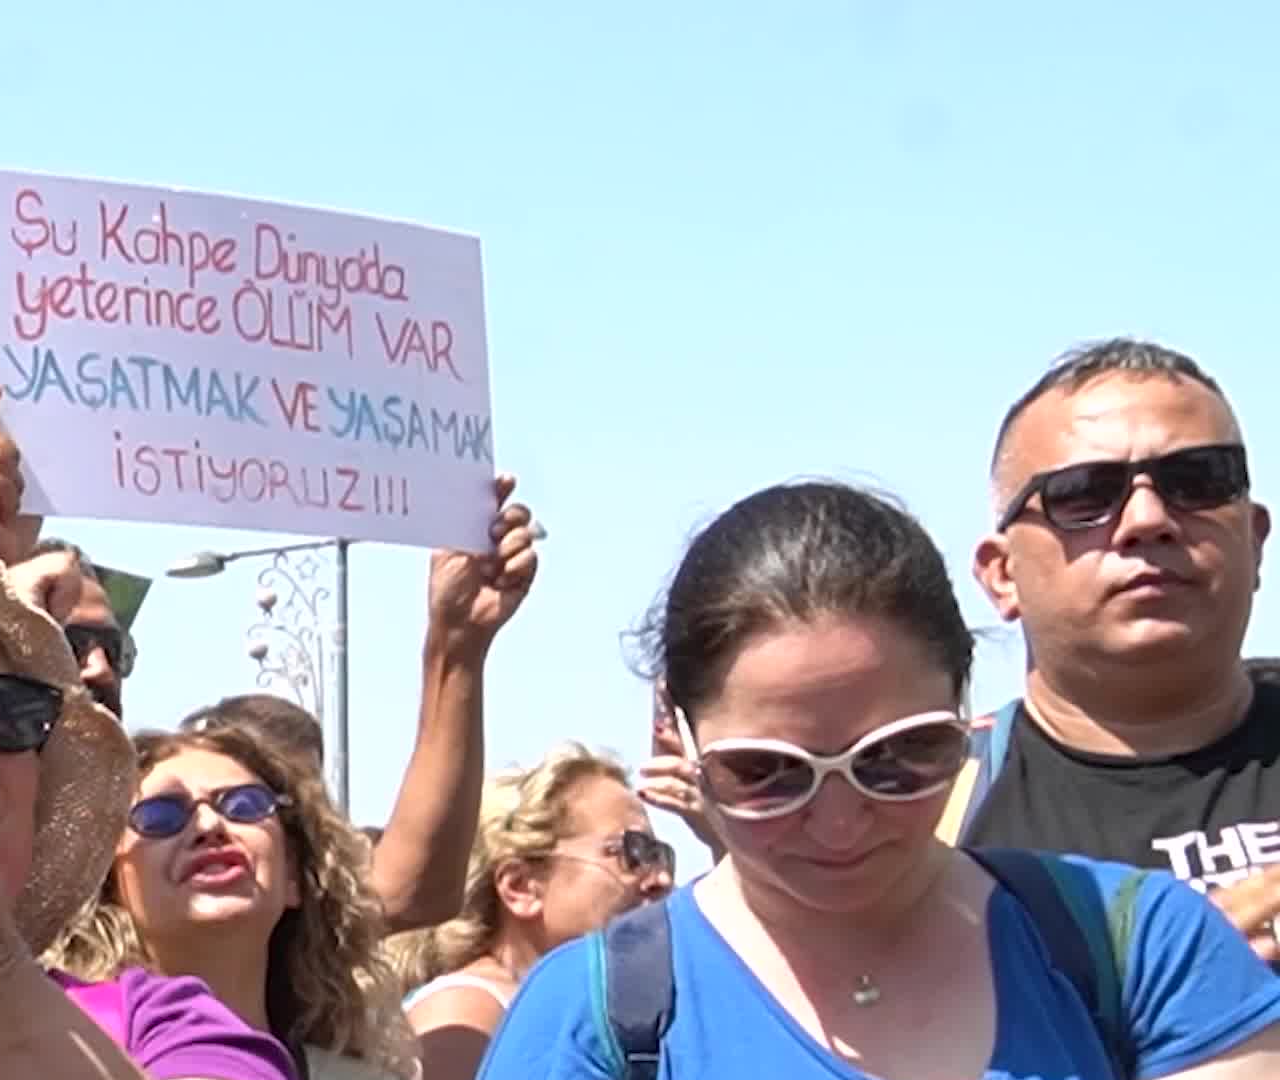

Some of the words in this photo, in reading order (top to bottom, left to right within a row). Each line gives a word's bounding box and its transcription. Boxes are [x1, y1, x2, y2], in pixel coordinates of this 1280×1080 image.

[11, 189, 78, 259] Şu
[99, 200, 237, 289] Kahpe
[14, 261, 223, 341] yeterince
[232, 278, 354, 360] ÖLÜM
[375, 310, 465, 383] VAR
[2, 343, 269, 428] YAŞATMAK
[271, 377, 321, 433] VE
[327, 386, 494, 464] YAŞAMAK
[1151, 821, 1280, 880] THE
